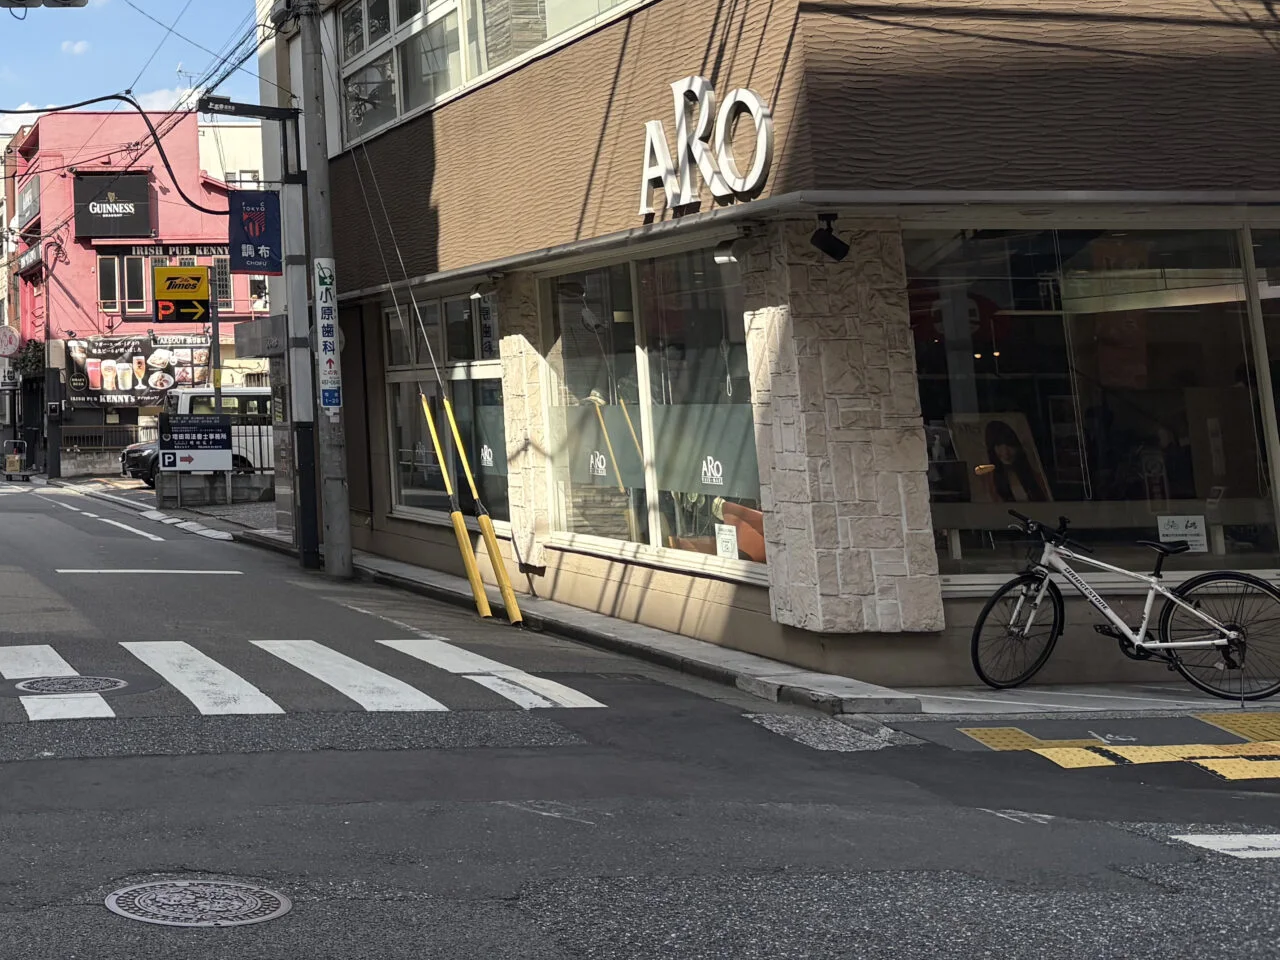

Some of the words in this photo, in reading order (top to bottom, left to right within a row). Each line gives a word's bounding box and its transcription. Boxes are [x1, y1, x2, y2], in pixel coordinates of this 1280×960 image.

[639, 75, 774, 216] ARO
[89, 202, 135, 214] GUINNESS
[132, 246, 163, 255] IRISH
[169, 246, 190, 255] PUB
[241, 244, 270, 258] 調布
[165, 277, 202, 290] Times
[158, 301, 175, 320] P
[320, 287, 335, 355] 小原歯科
[165, 454, 174, 466] P
[590, 451, 606, 470] ARO
[702, 456, 722, 477] ARO
[1064, 567, 1108, 611] BRIDGESTONE
